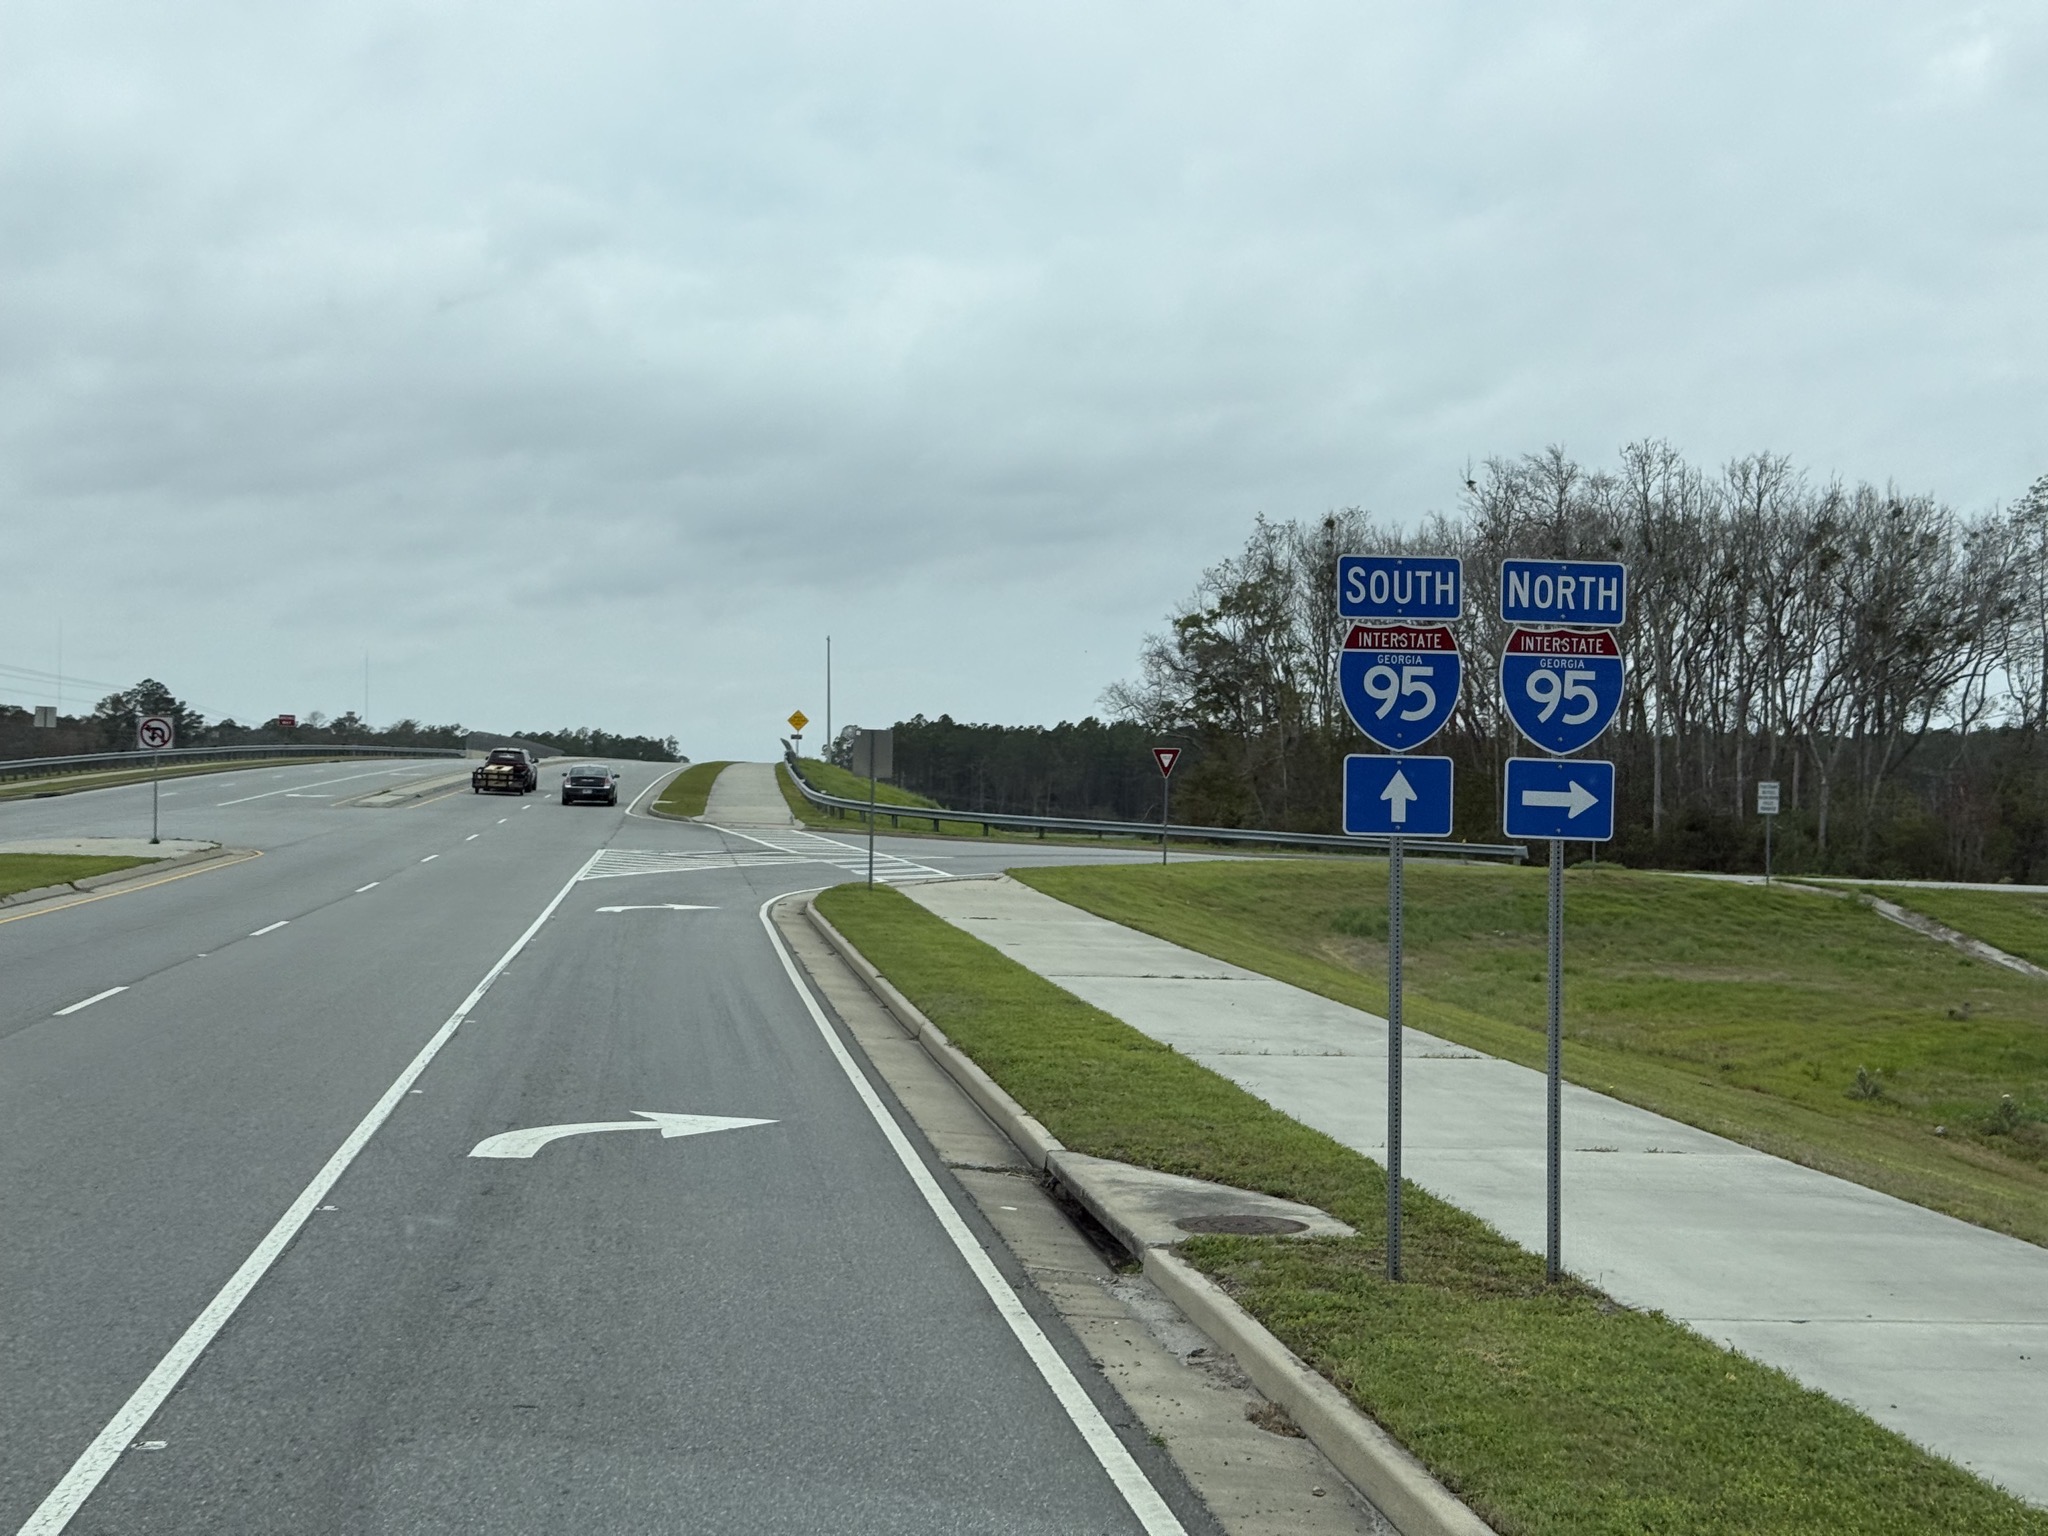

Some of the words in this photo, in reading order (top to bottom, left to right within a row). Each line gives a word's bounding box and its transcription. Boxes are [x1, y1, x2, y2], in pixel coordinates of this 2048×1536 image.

[1346, 566, 1454, 605] SOUTH
[1508, 571, 1617, 611] NORTH
[1358, 632, 1442, 649] INTERSTATE
[1520, 636, 1604, 653] INTERSTATE
[1377, 654, 1423, 665] GEORGIA
[1539, 658, 1585, 669] GEORGIA
[1363, 665, 1436, 721] 95
[1526, 669, 1598, 725] 95
